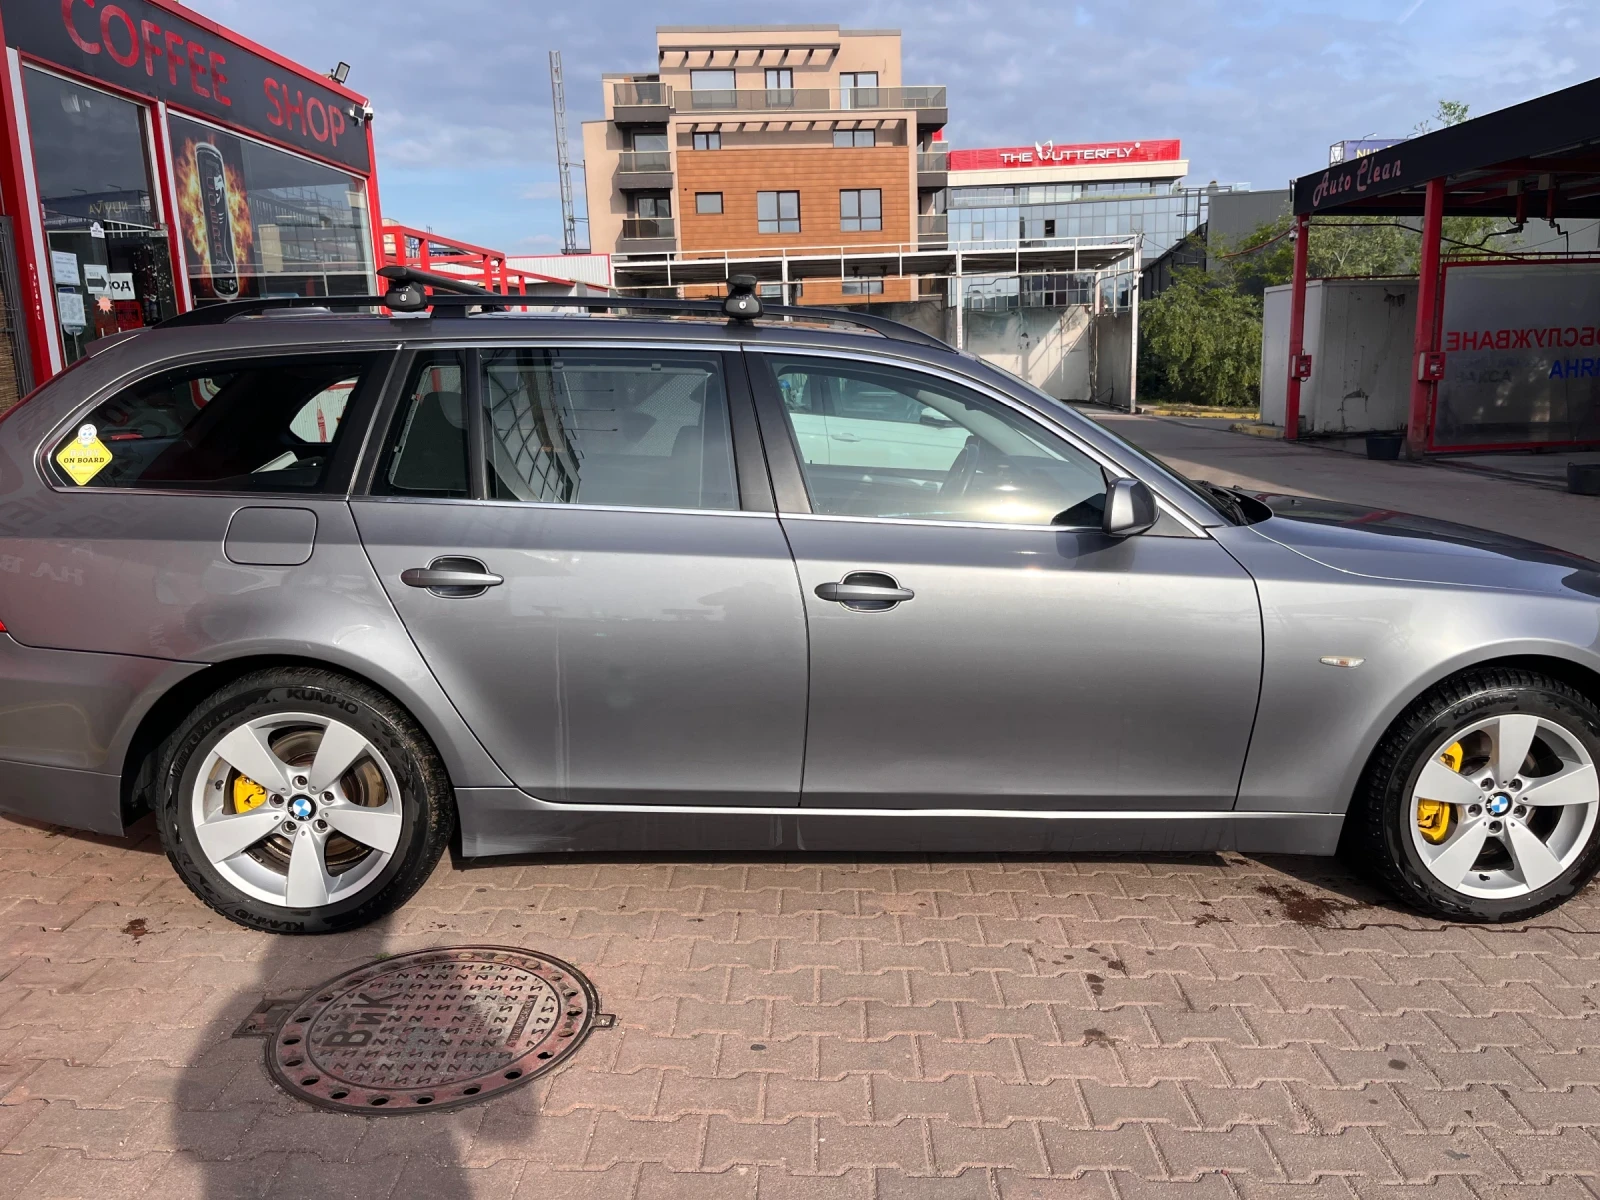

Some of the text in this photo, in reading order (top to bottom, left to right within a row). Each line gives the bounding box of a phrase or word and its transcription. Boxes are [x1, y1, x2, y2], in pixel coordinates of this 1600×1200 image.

[61, 0, 346, 147] COFFEE SHOP
[1000, 152, 1033, 163] THE
[1312, 156, 1402, 207] Auto Clean
[286, 688, 359, 715] KUMHO
